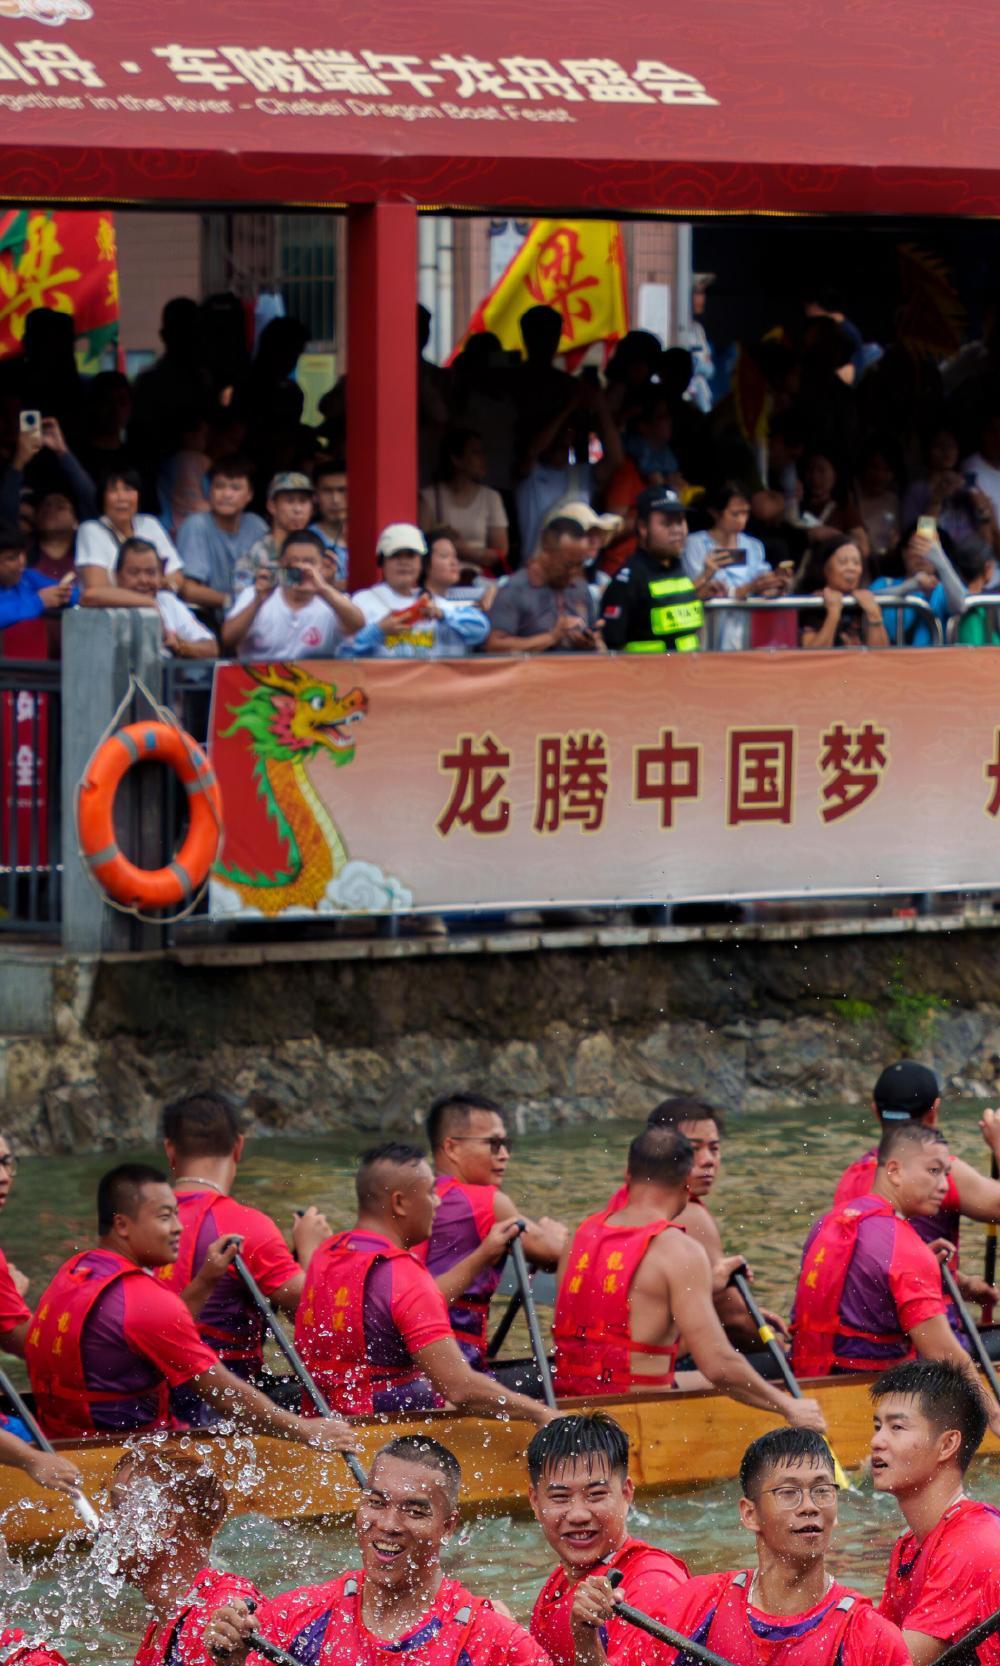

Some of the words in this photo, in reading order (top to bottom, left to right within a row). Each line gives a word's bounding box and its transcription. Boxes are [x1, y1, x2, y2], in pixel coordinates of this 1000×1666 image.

[117, 95, 167, 112] the
[163, 96, 234, 113] River
[345, 99, 444, 121] Dragon
[440, 102, 508, 120] Boat
[435, 721, 889, 836] 龙腾中国梦
